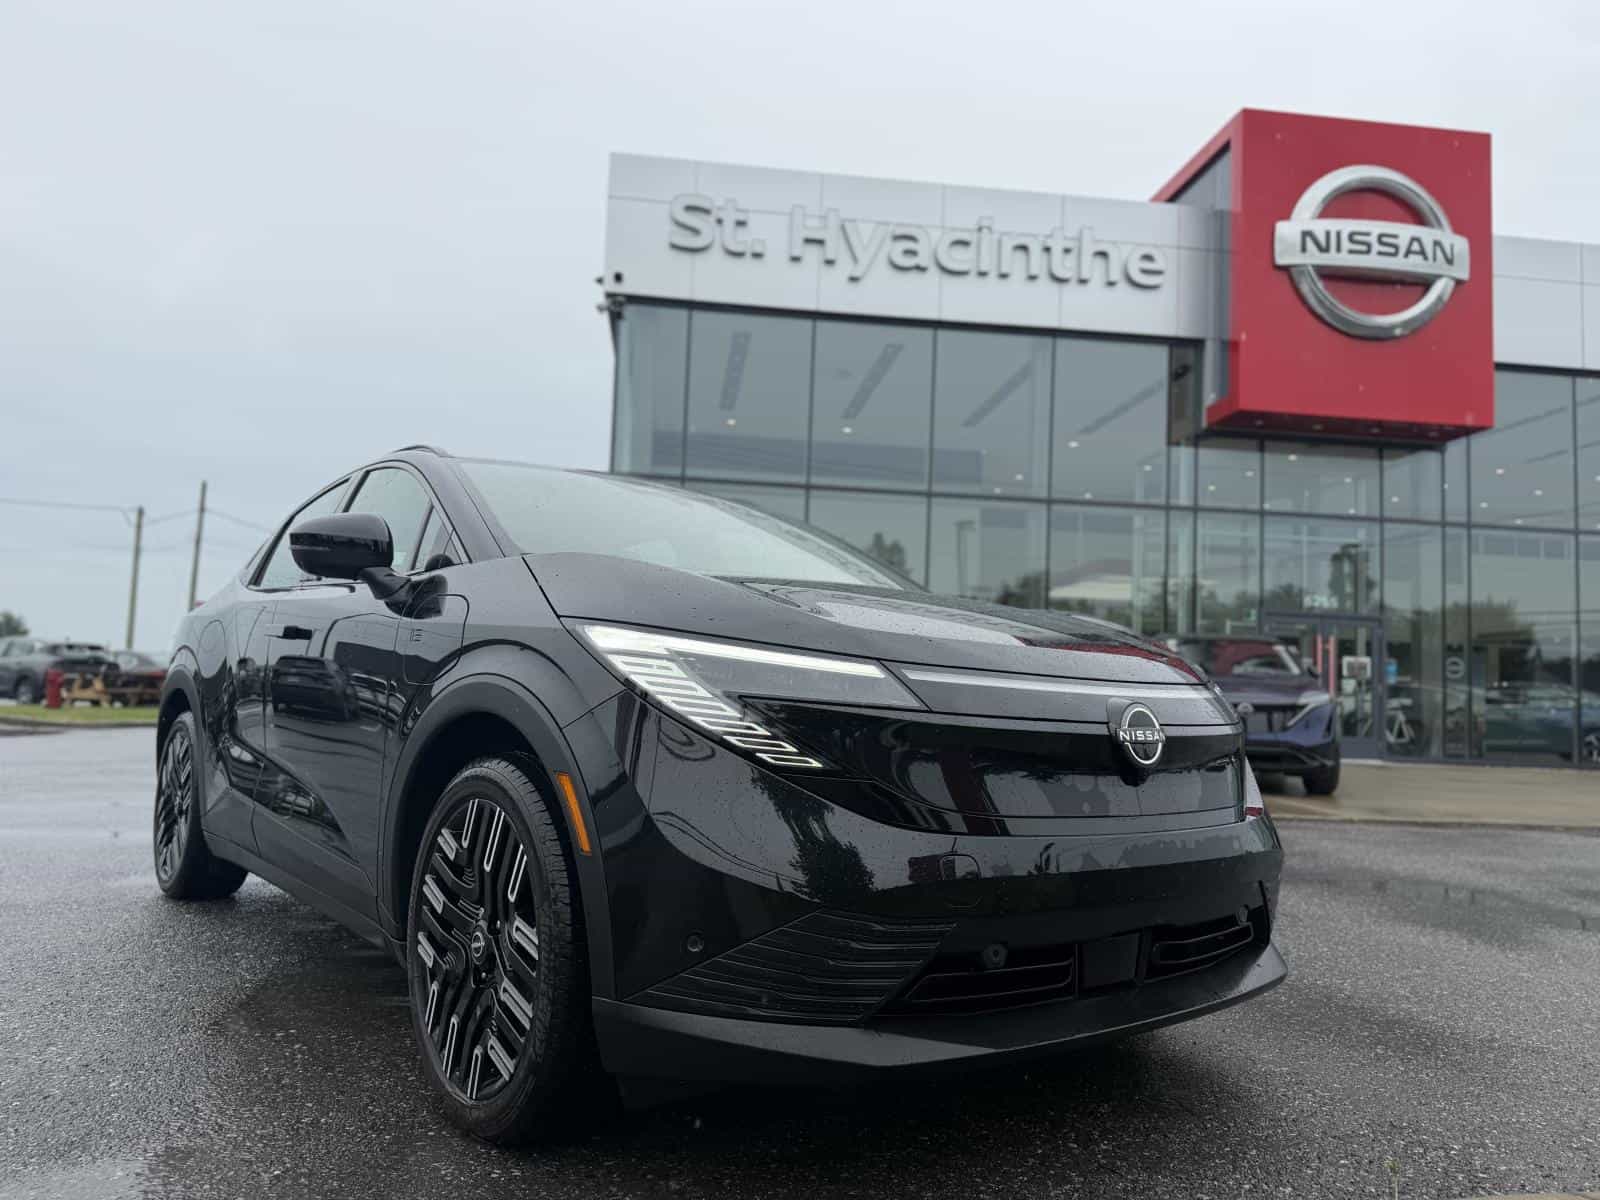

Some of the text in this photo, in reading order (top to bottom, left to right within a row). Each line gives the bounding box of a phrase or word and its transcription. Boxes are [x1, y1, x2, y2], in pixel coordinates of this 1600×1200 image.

[669, 192, 1167, 290] St. Hyacinthe
[1300, 229, 1455, 266] NISSAN
